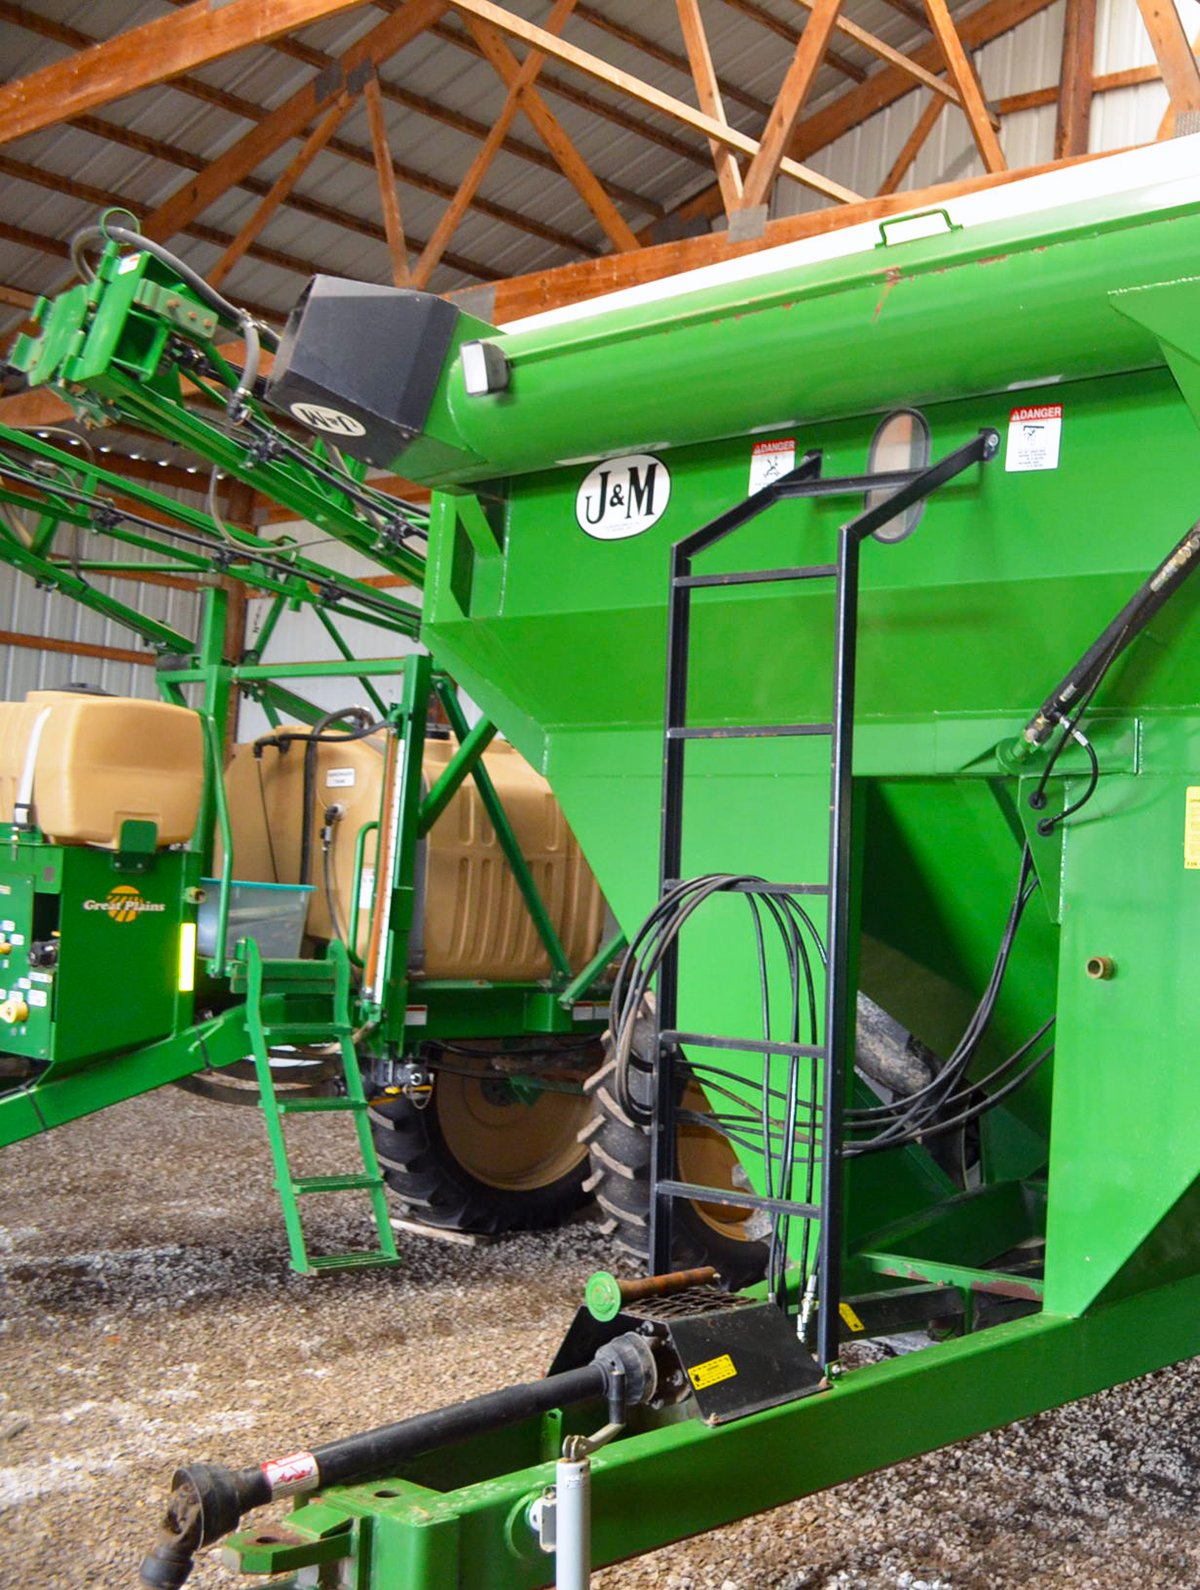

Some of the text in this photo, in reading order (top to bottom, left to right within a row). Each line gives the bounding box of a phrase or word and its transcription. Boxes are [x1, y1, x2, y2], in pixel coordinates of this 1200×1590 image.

[296, 407, 358, 433] J&M
[1020, 406, 1062, 420] DANGER
[760, 439, 796, 453] DANGER
[584, 462, 660, 525] J&M
[83, 899, 166, 912] Great Plains
